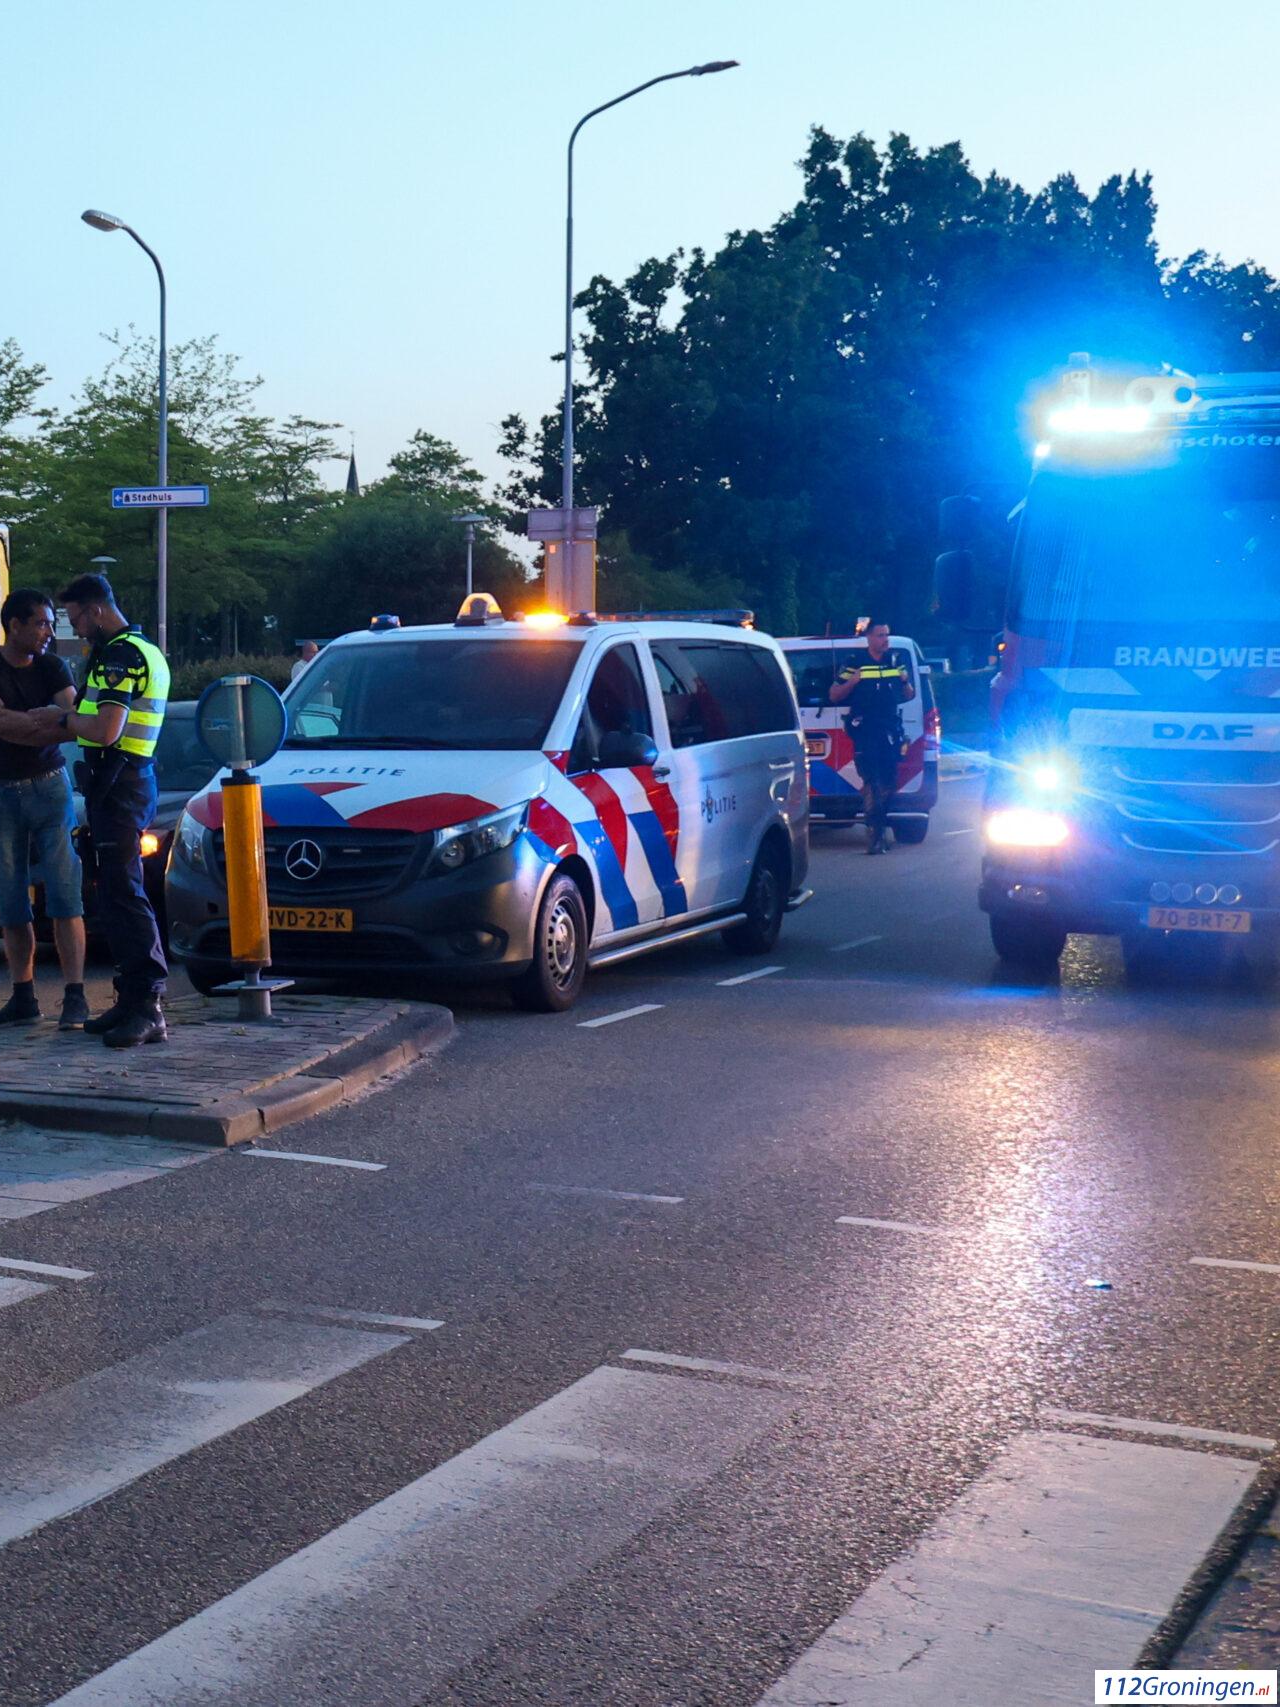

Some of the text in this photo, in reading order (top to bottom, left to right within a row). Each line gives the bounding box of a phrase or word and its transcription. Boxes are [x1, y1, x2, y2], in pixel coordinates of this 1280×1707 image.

[131, 493, 172, 502] Stadhuis
[1153, 723, 1254, 740] DAF
[288, 766, 407, 777] POLITIE
